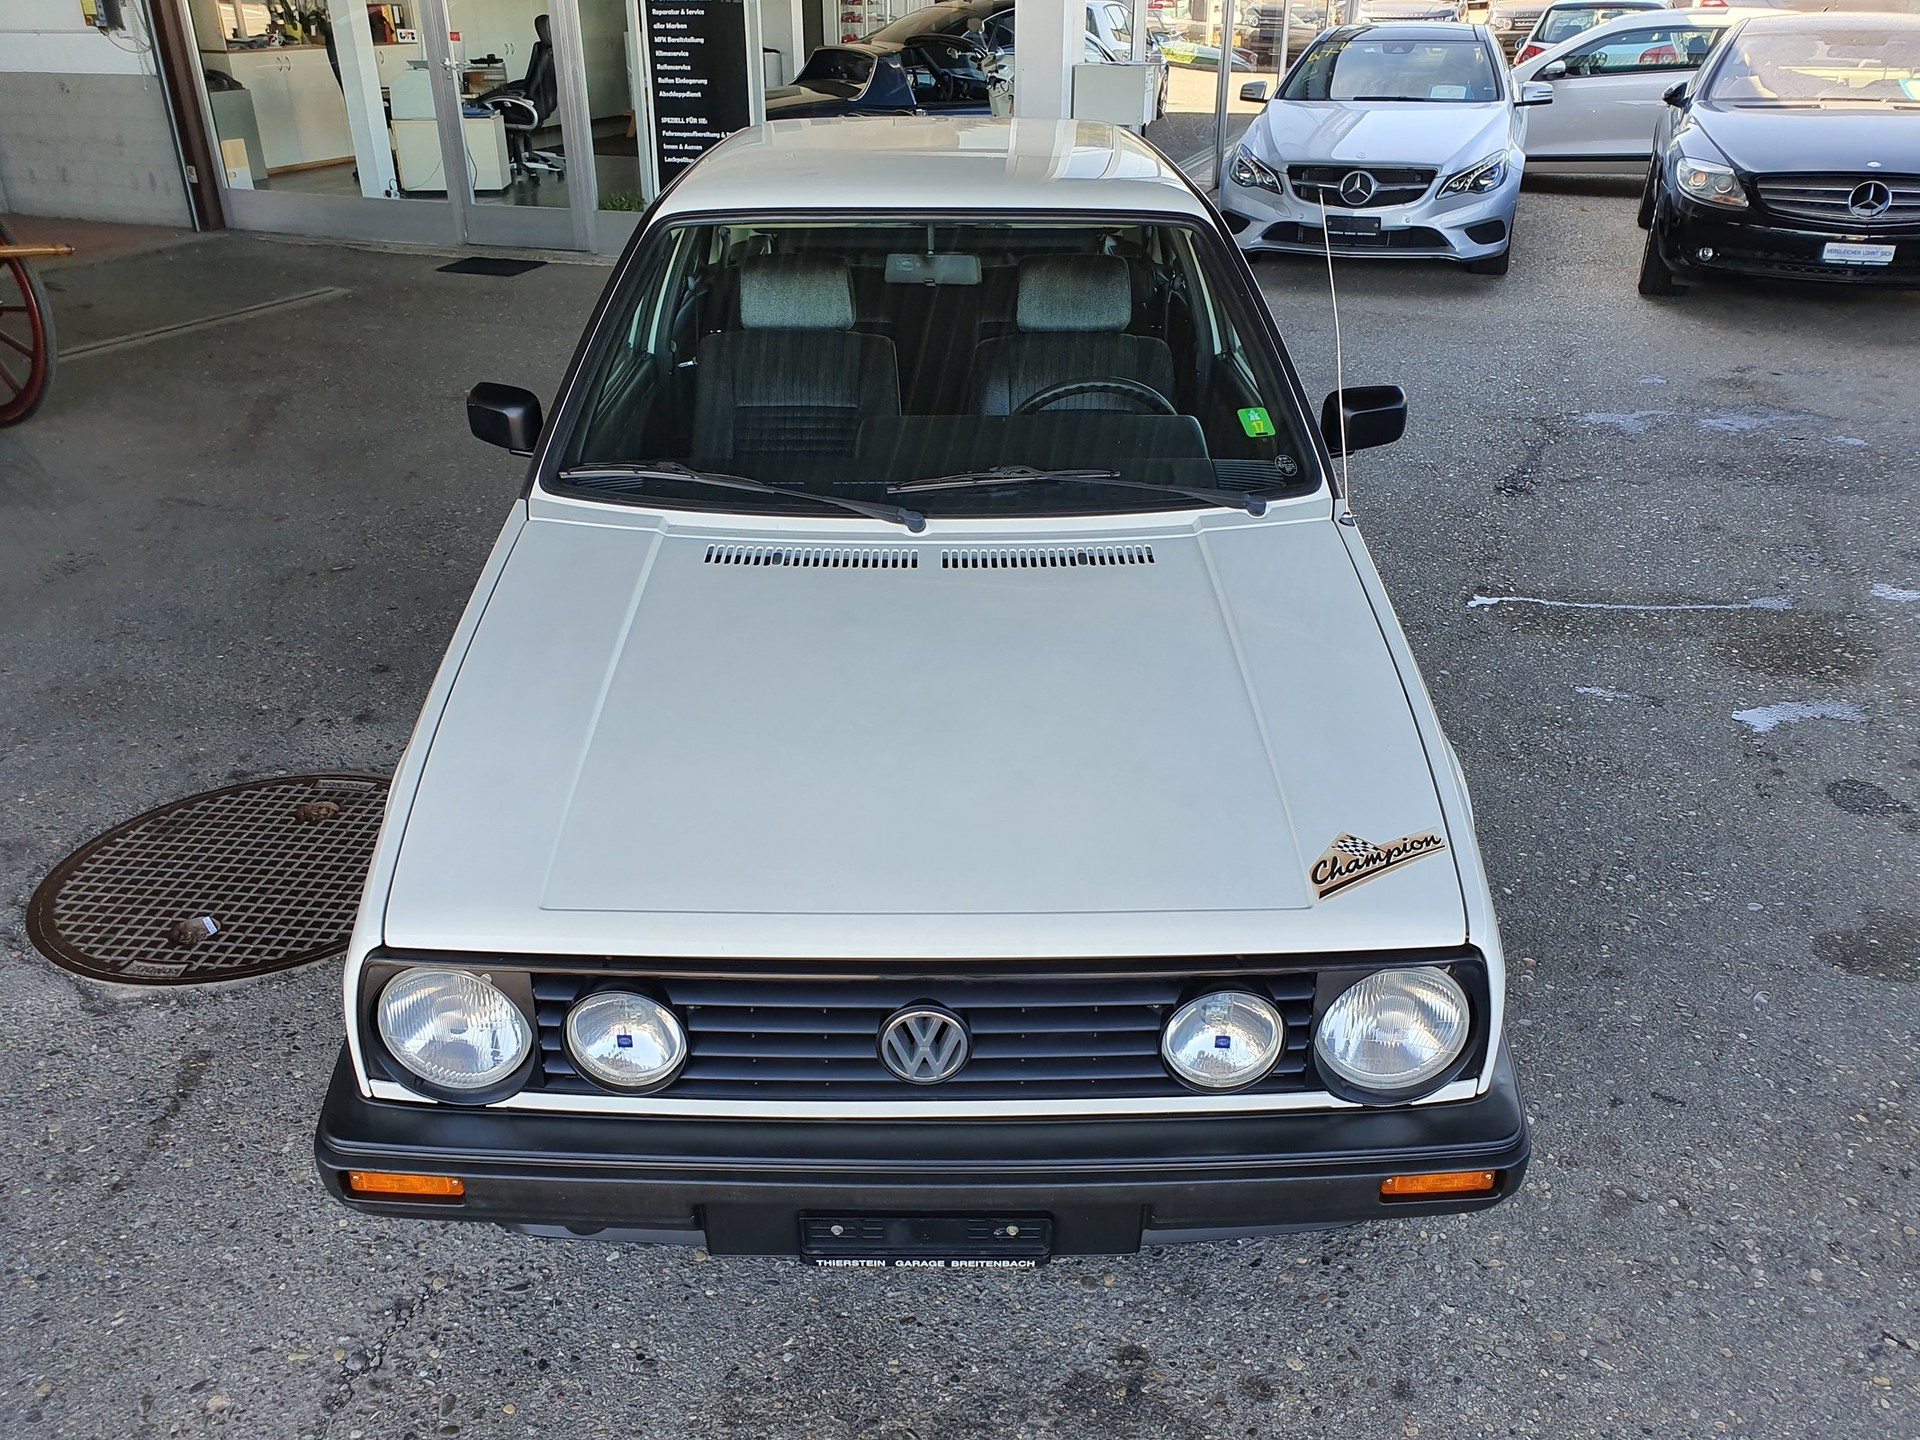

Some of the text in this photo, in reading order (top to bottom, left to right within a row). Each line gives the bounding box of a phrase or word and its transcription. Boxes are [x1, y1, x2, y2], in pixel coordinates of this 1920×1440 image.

[686, 116, 697, 124] FÜR
[1826, 248, 1861, 256] VERGLEICHEN
[1251, 421, 1264, 432] 17
[1311, 835, 1442, 884] Champion
[882, 1012, 967, 1081] VW
[816, 1259, 885, 1267] THIERSTEIN
[951, 1260, 1035, 1268] BREITENBACH
